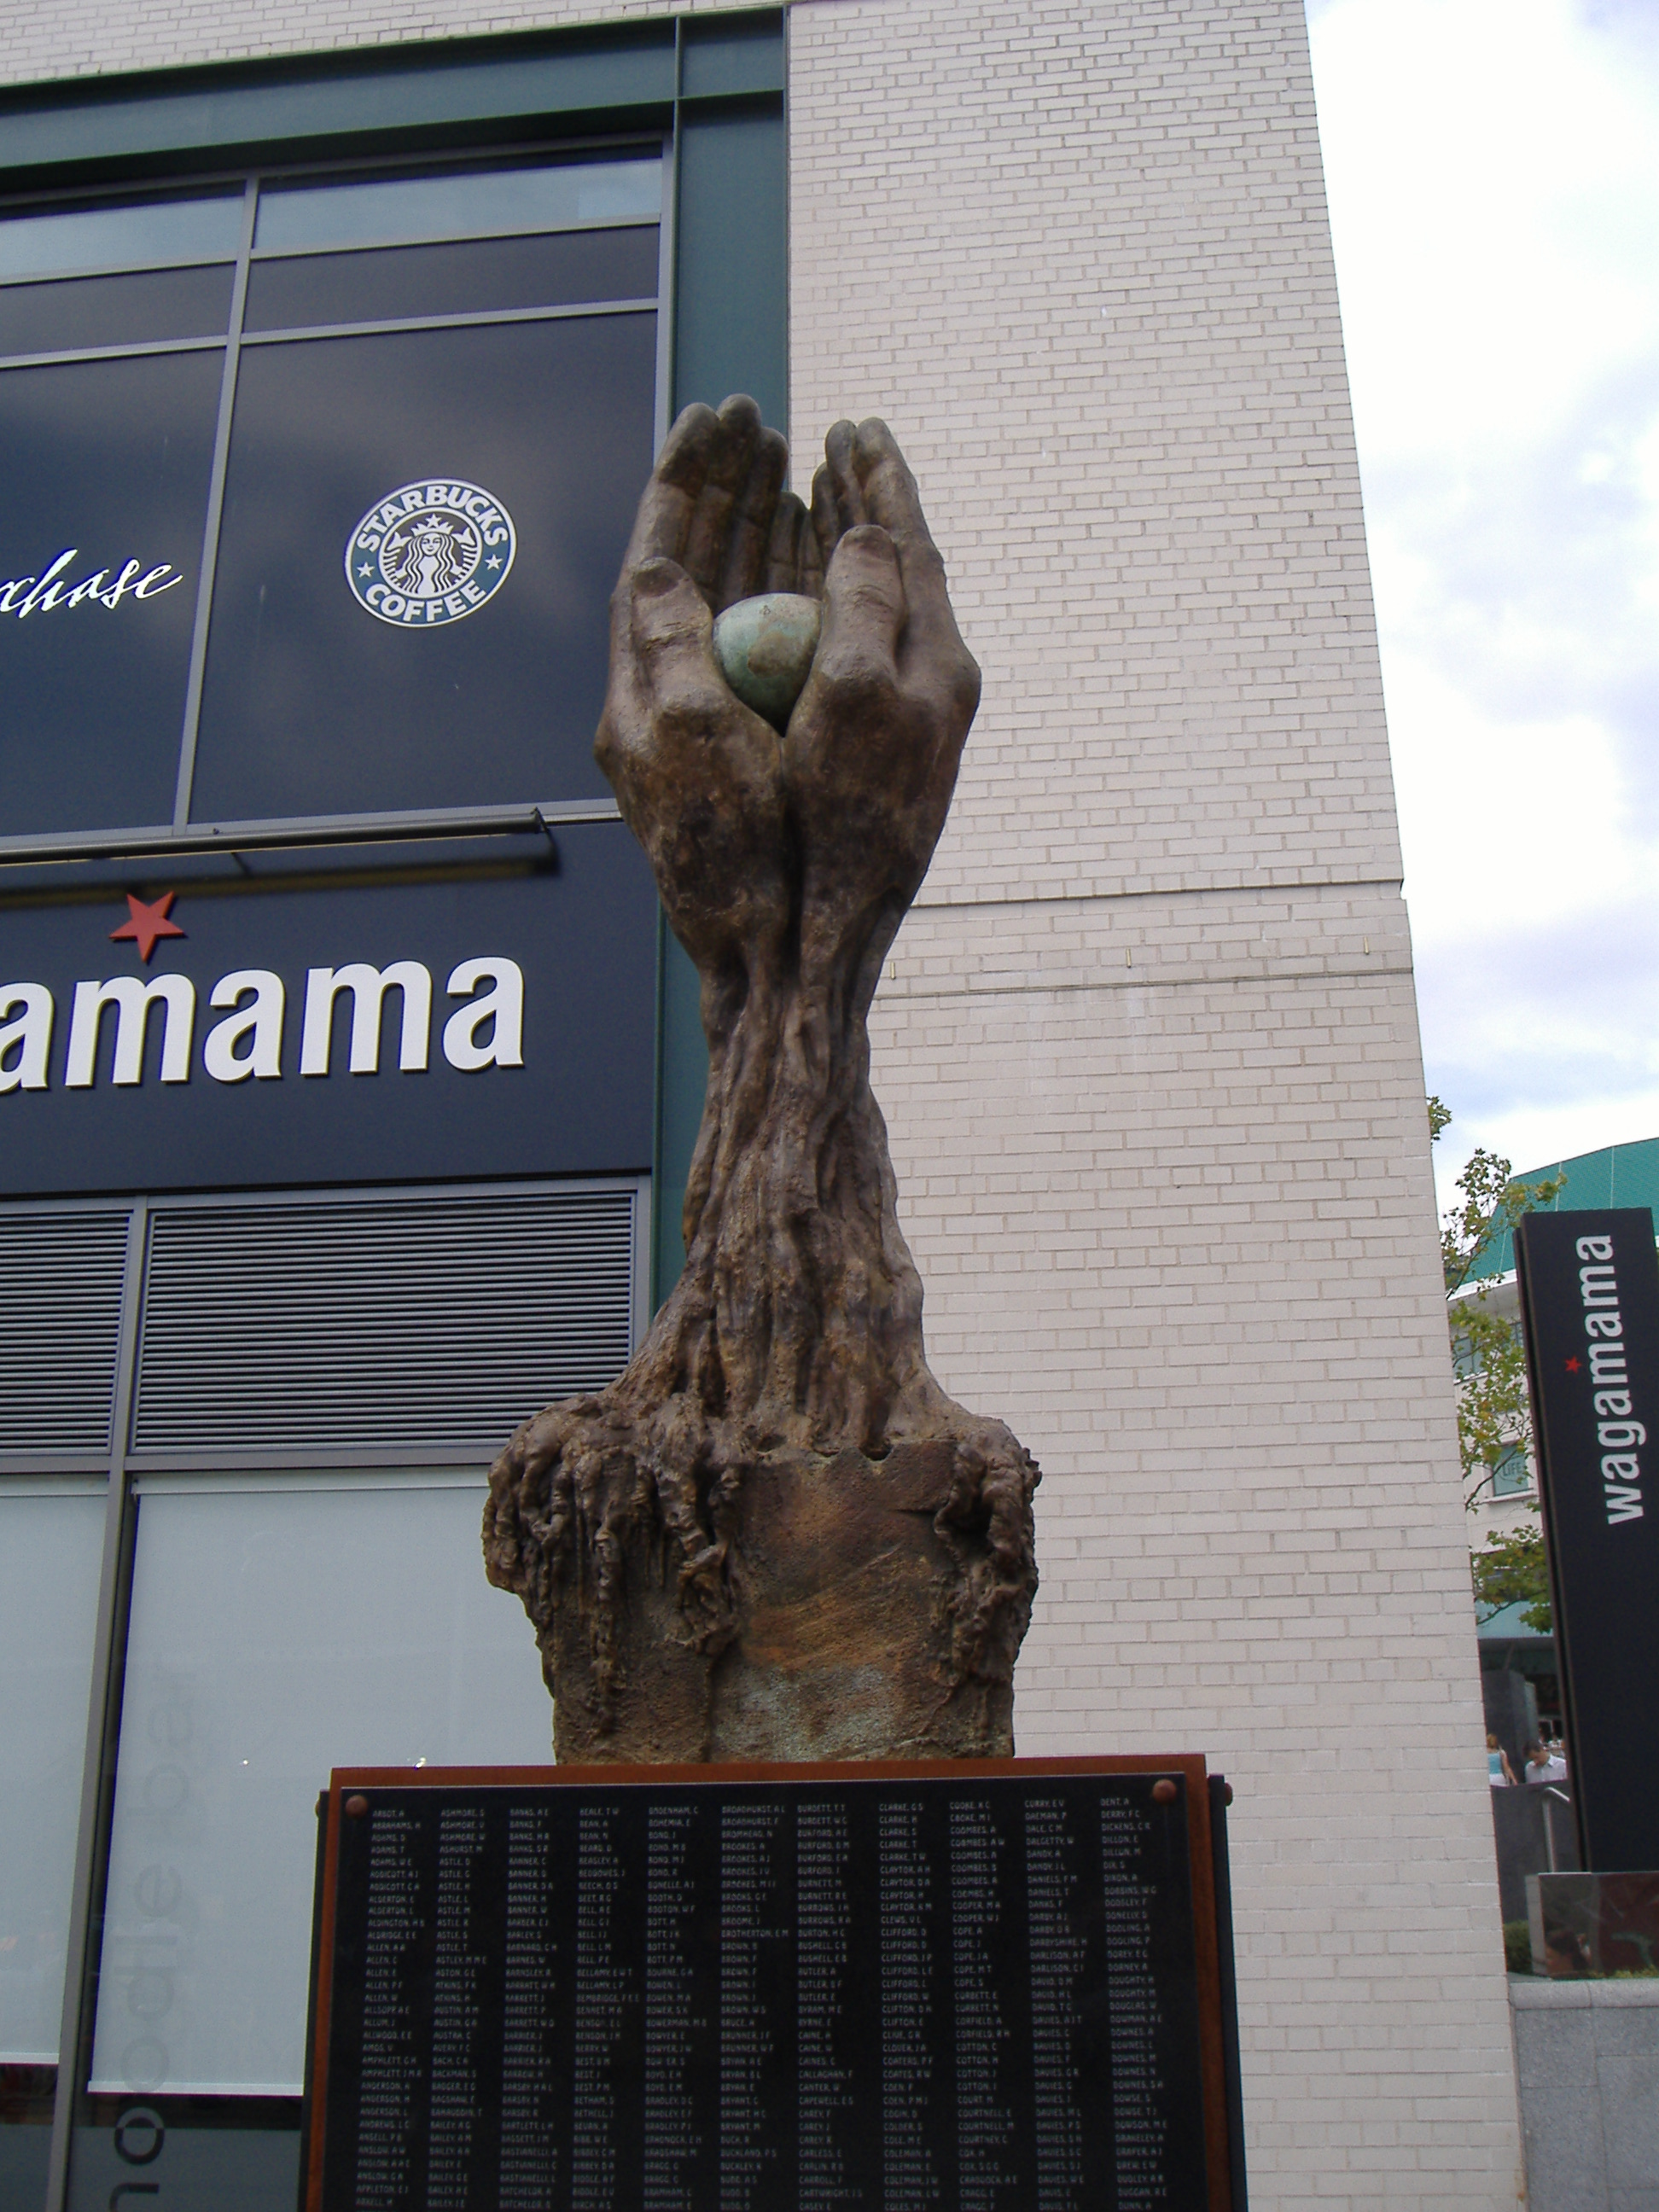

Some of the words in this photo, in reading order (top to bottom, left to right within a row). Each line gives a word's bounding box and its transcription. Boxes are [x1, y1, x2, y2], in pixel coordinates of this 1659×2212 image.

[357, 485, 509, 552] STARBUCKS
[365, 579, 486, 622] COFFEE
[1575, 1235, 1647, 1525] wagamama
